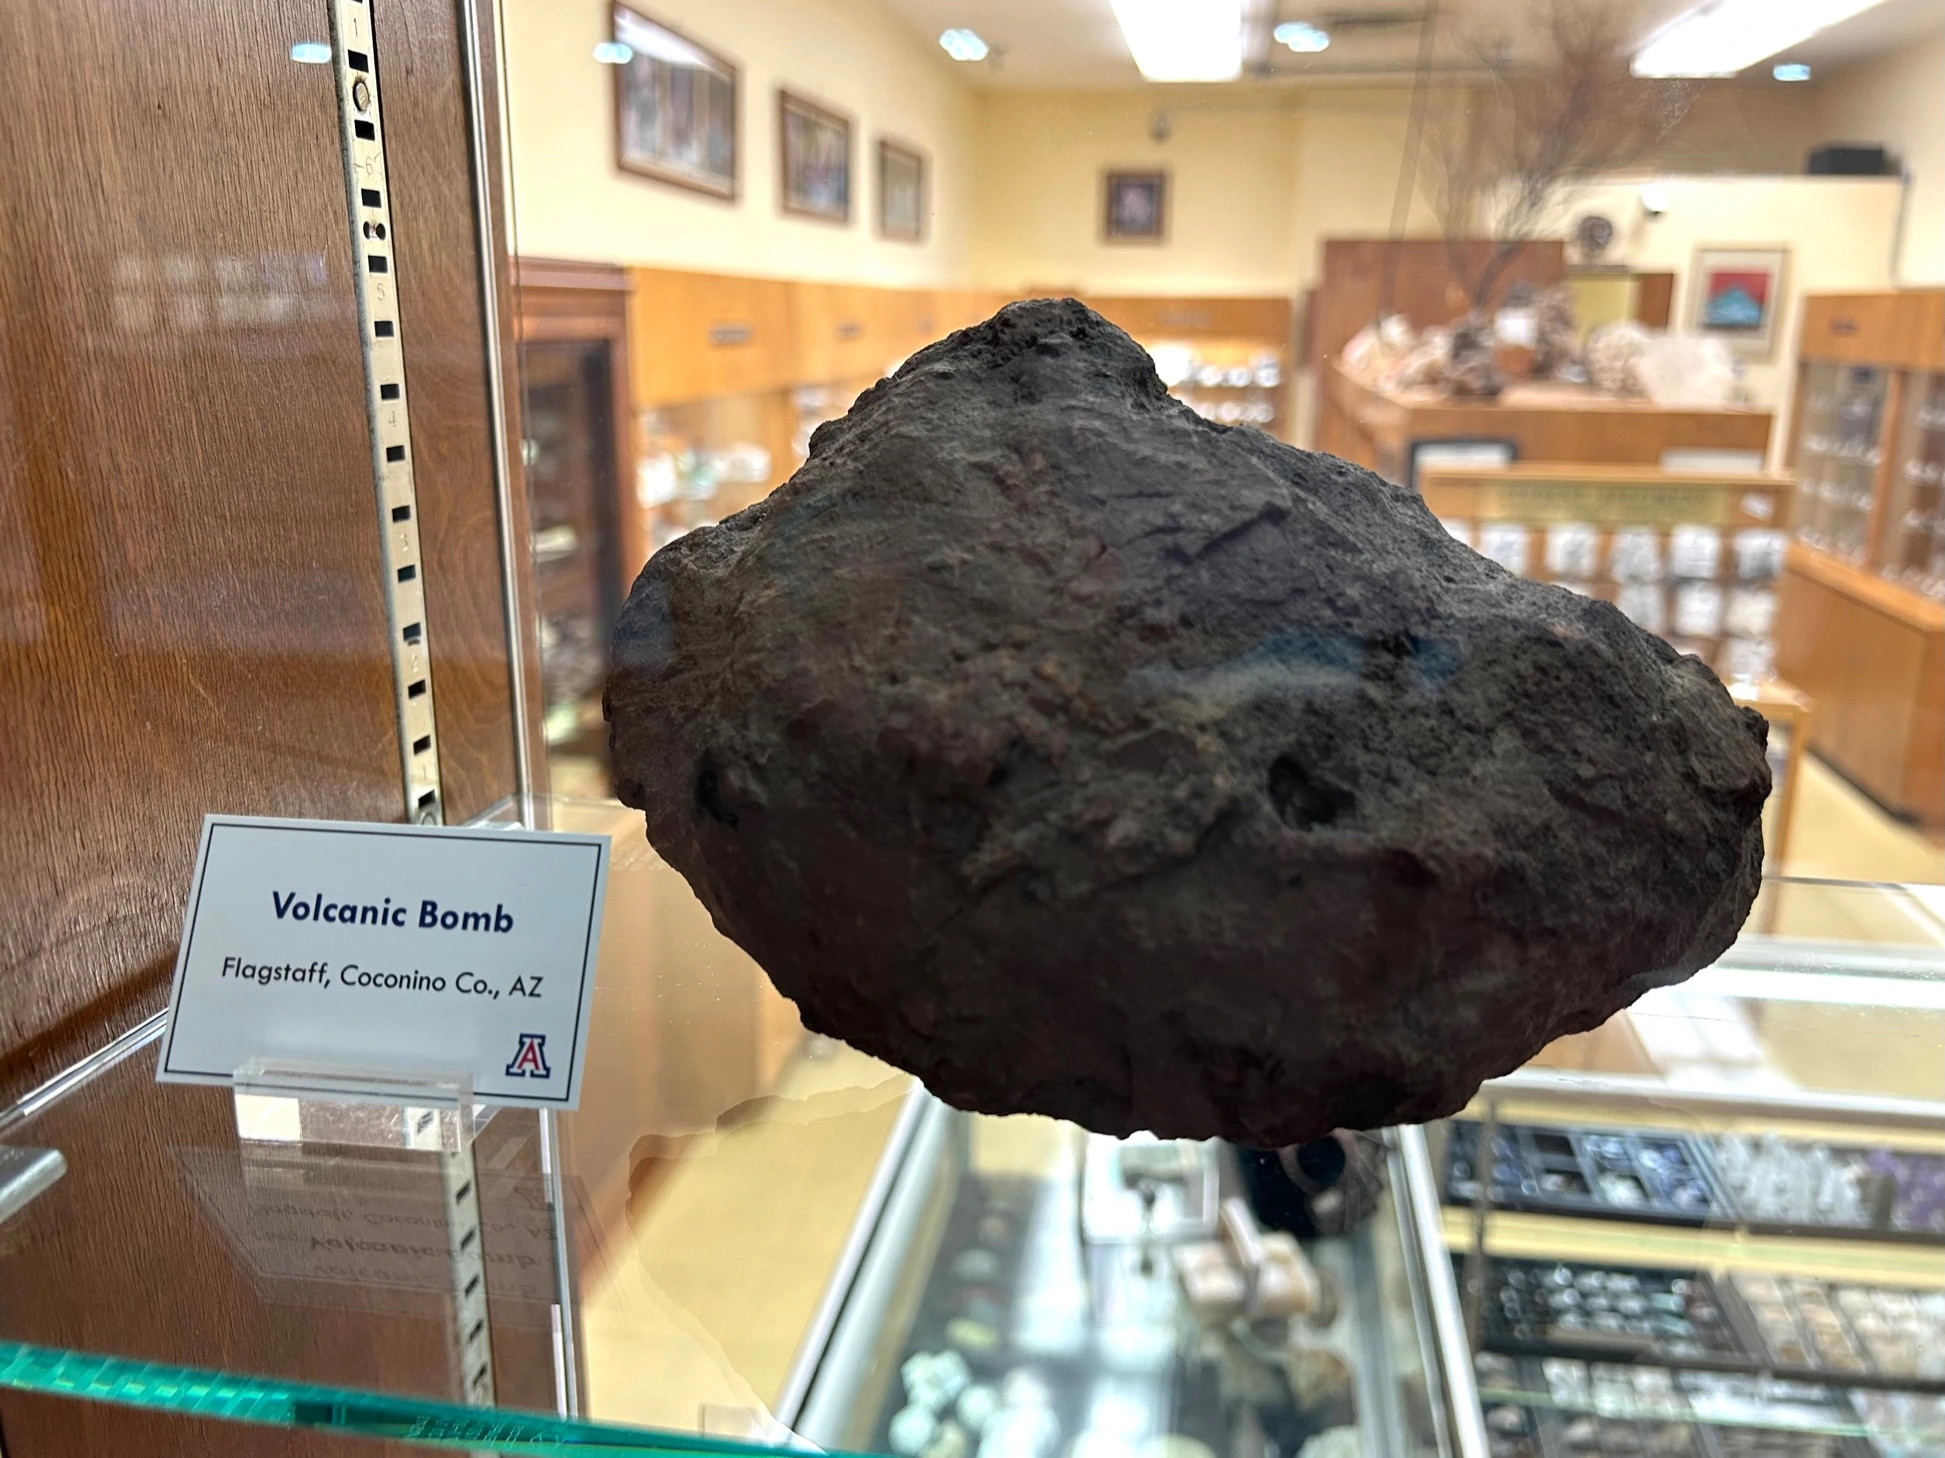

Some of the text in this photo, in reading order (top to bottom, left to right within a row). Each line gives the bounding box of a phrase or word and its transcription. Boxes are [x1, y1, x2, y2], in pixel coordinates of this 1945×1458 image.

[272, 891, 514, 933] Volcanic Bomb
[222, 957, 544, 999] Flagstaff, Coconino Co., AZ
[505, 1033, 551, 1079] A
